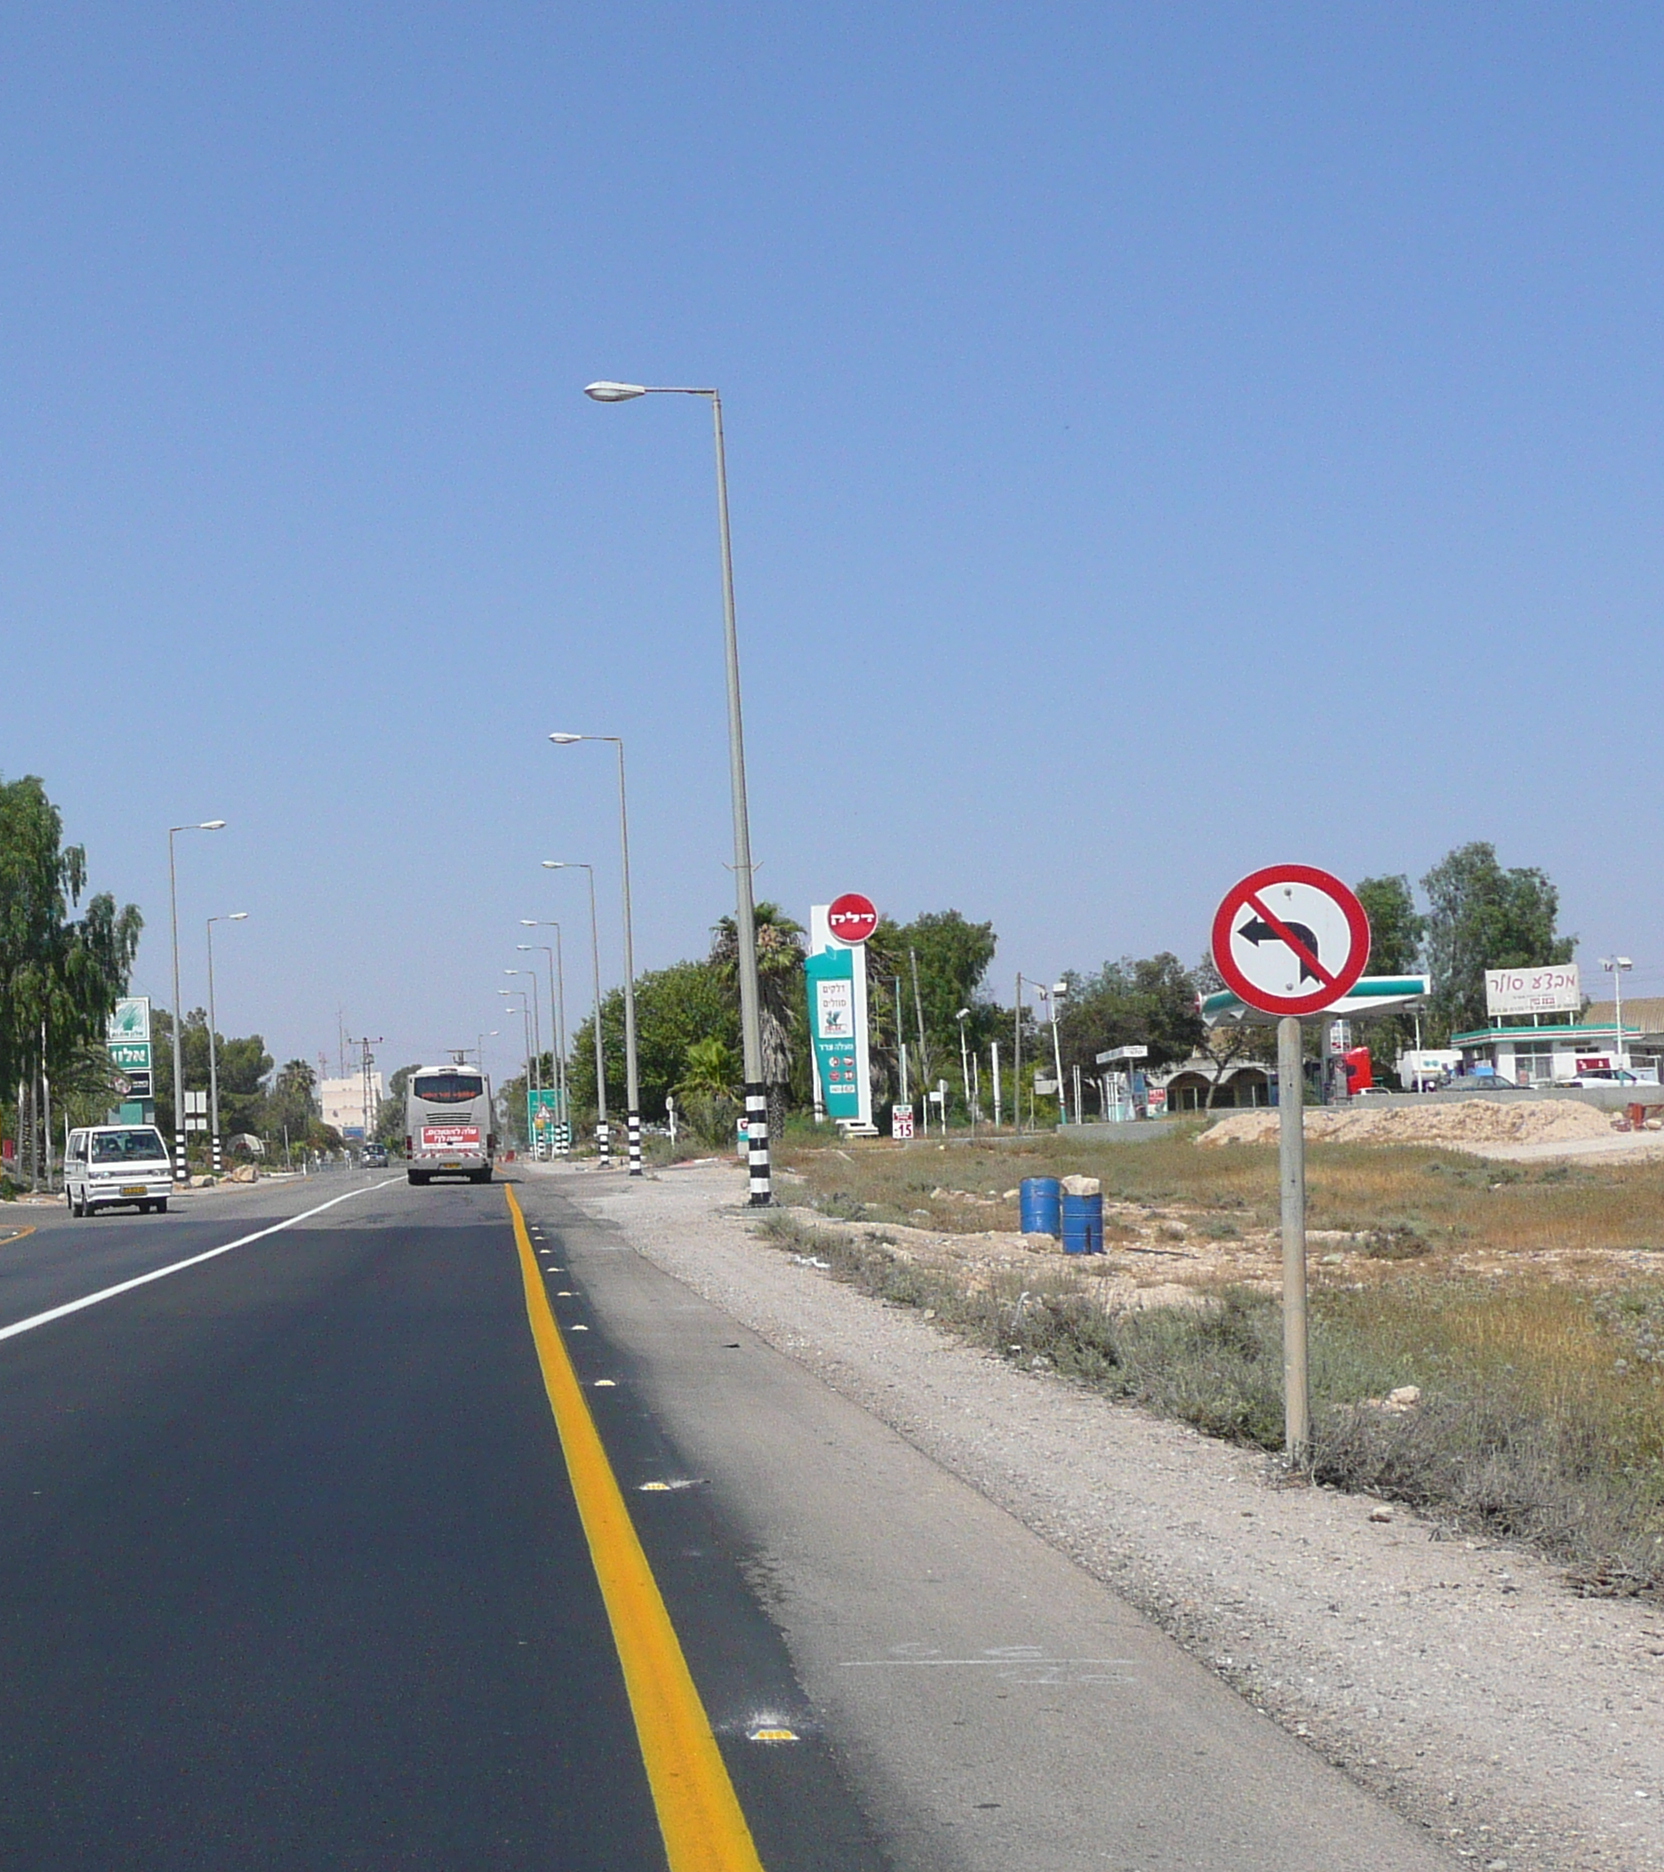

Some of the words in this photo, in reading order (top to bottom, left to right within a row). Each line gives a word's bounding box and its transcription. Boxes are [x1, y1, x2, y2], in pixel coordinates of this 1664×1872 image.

[830, 911, 875, 926] דלק
[1489, 974, 1524, 994] סולר
[1531, 973, 1576, 990] מבצע
[111, 1047, 146, 1064] אלון
